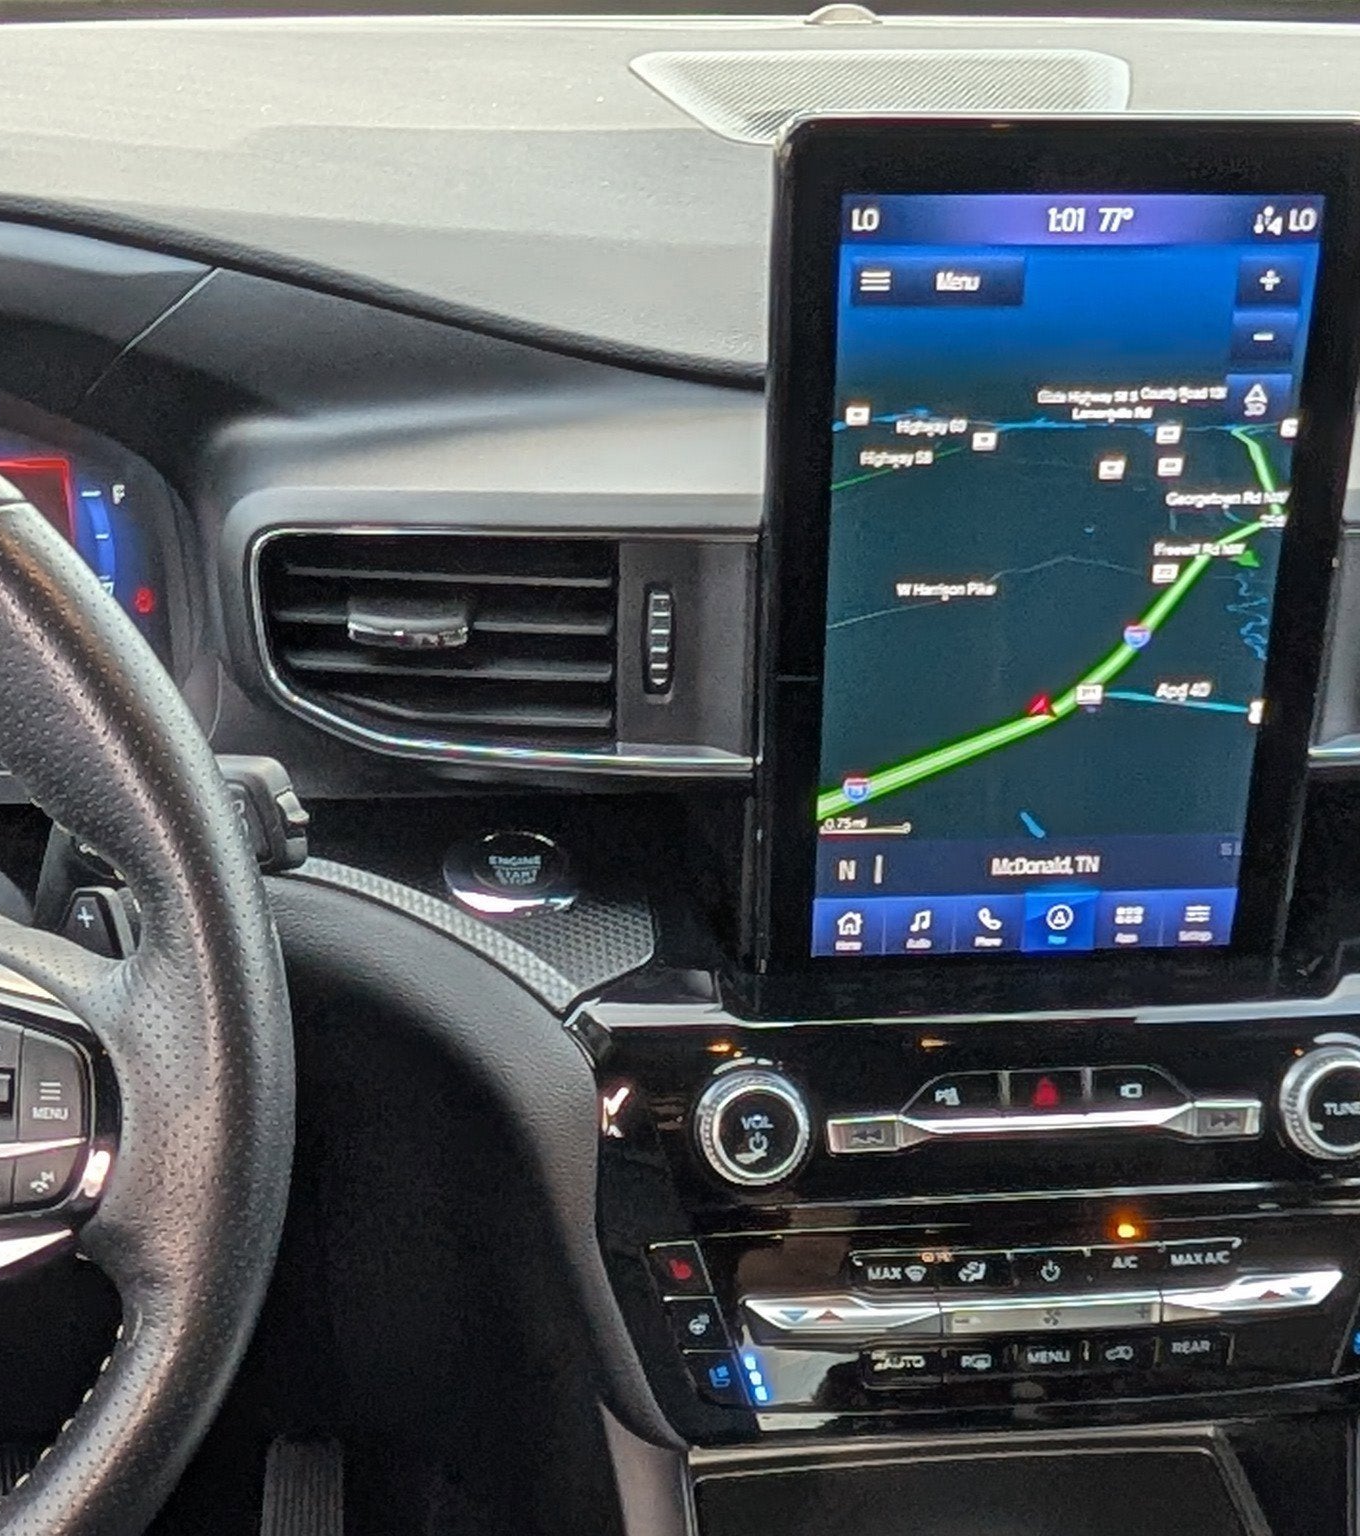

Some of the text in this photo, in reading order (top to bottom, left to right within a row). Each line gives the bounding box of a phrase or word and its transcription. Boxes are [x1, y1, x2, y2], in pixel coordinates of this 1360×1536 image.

[851, 208, 880, 232] LO
[1048, 207, 1085, 232] 1:01
[1289, 207, 1318, 231] LO
[935, 272, 981, 292] Menu
[112, 484, 126, 505] F
[1075, 854, 1101, 875] TN
[32, 1107, 68, 1121] MENU
[741, 1115, 773, 1131] VOL
[1112, 1254, 1139, 1270] A/C
[1170, 1249, 1231, 1267] MAX A/C
[868, 1266, 903, 1282] MAX
[1171, 1339, 1211, 1355] REAR
[1026, 1348, 1071, 1365] MENU
